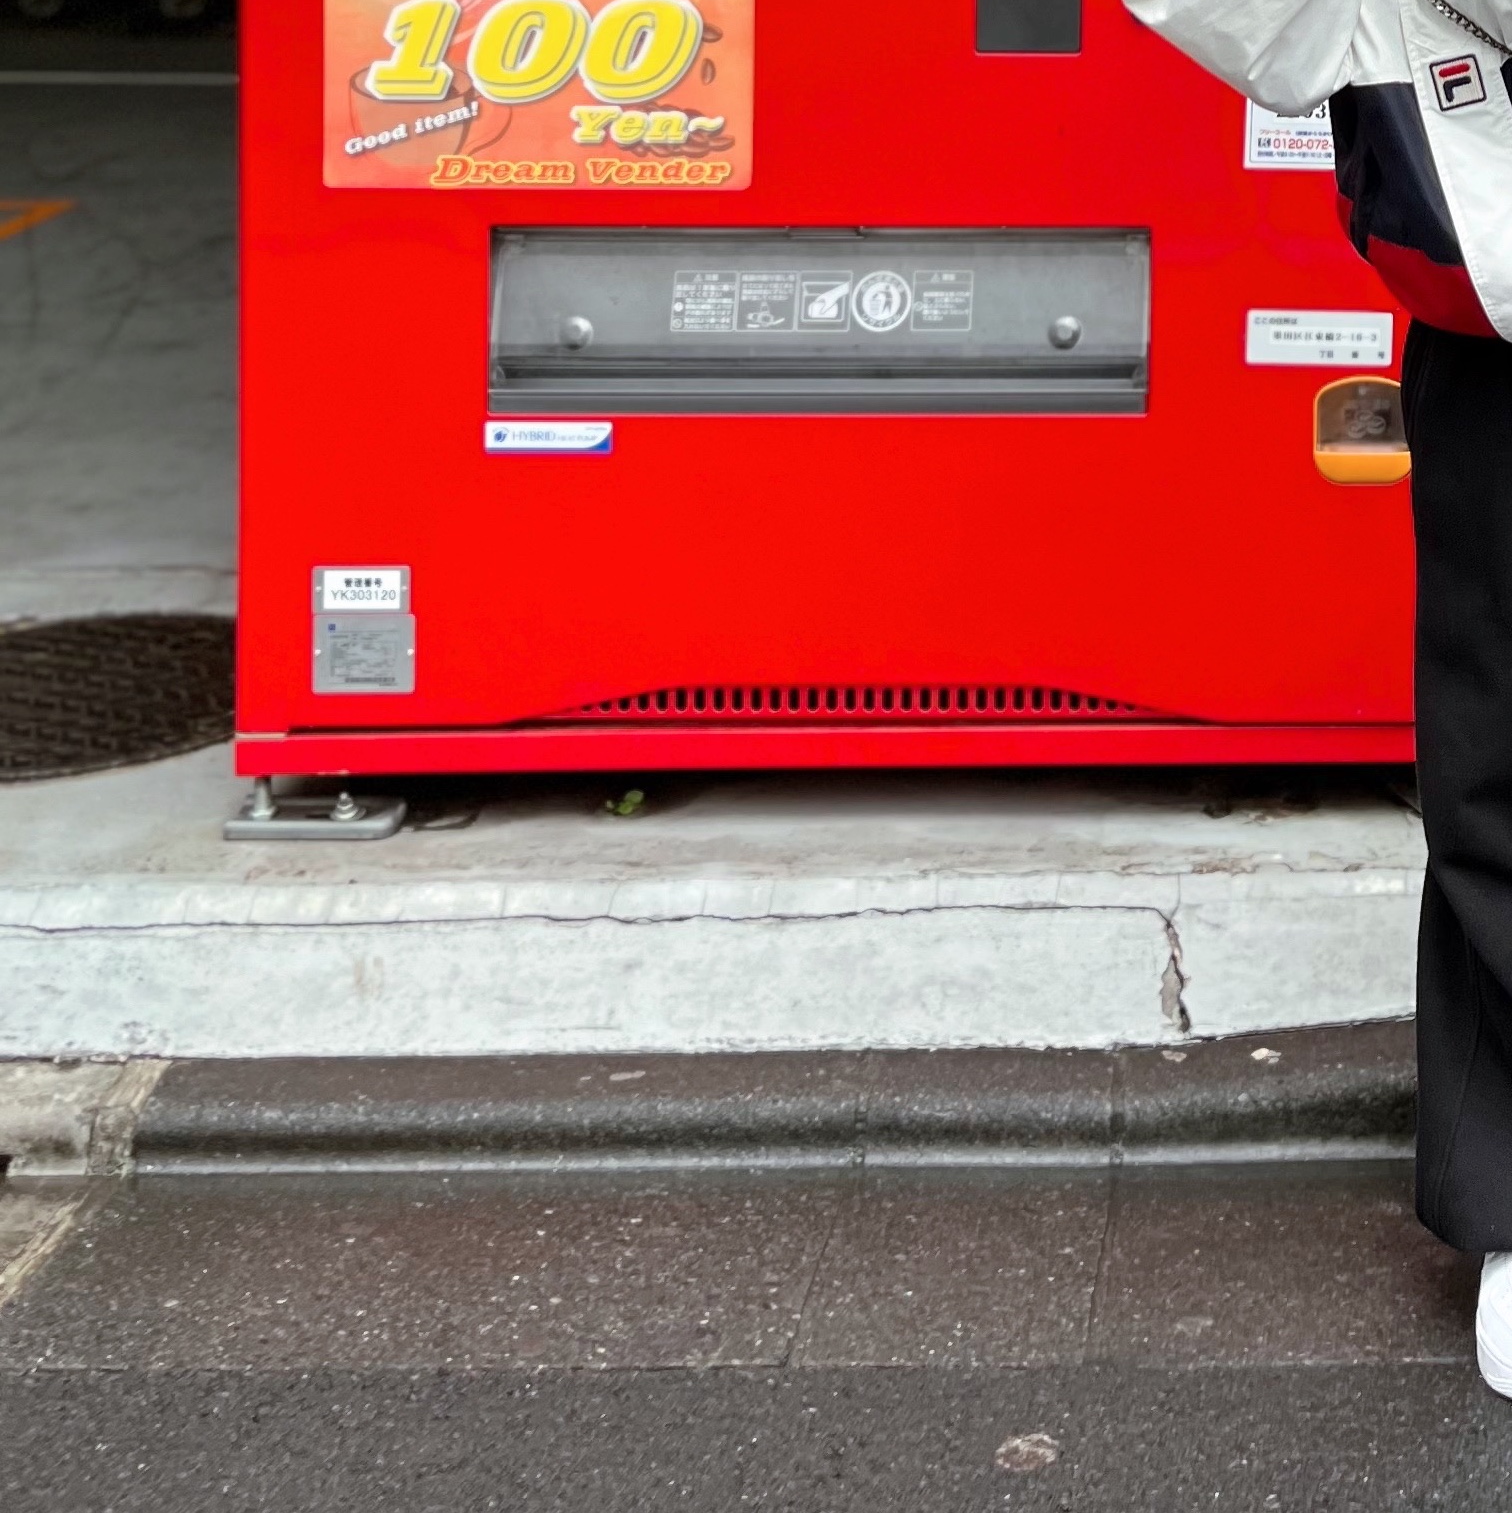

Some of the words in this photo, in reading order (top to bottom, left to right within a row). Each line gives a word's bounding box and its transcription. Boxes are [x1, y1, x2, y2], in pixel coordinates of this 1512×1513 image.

[345, 123, 408, 156] Good
[414, 100, 480, 134] item!
[1273, 137, 1335, 150] 0120-072-
[430, 155, 576, 186] Dream
[587, 158, 731, 185] Vender
[331, 589, 397, 601] YK303120
